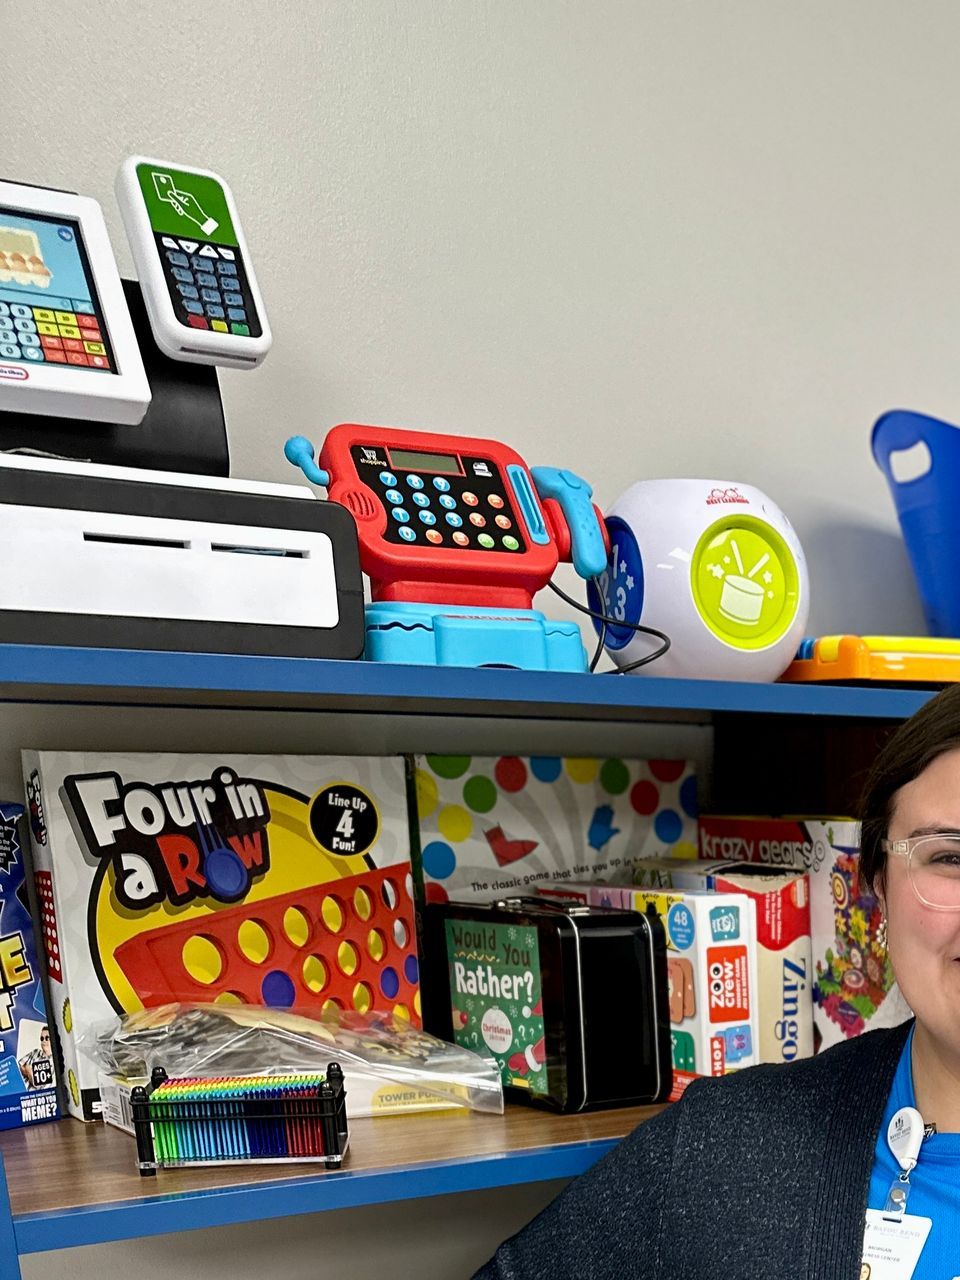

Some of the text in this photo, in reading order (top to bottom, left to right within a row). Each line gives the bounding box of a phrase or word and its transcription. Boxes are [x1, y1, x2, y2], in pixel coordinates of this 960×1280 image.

[360, 458, 388, 467] shopping
[612, 544, 619, 579] 1
[614, 586, 627, 622] 3
[74, 777, 217, 848] Four
[219, 771, 265, 820] in
[328, 792, 367, 813] Line Up
[335, 809, 355, 838] 4
[332, 836, 356, 852] Fun!
[700, 827, 813, 866] krazy gears
[120, 852, 159, 900] a
[471, 882, 489, 892] The
[491, 877, 522, 891] classic
[523, 872, 550, 885] game
[552, 868, 572, 881] that
[573, 863, 590, 875] ties
[592, 863, 608, 874] you
[609, 858, 622, 868] up
[623, 856, 632, 867] in
[673, 910, 689, 927] 48
[452, 926, 497, 952] Would
[502, 942, 532, 968] You
[454, 961, 534, 1004] Rather?
[773, 957, 807, 1062] Zingo
[482, 1022, 512, 1036] Christmas
[33, 1062, 50, 1071] AGES
[34, 1071, 52, 1083] 10+
[21, 1094, 57, 1109] WHAT DO YOU
[378, 1091, 417, 1103] TOWER
[22, 1102, 58, 1122] MEME?
